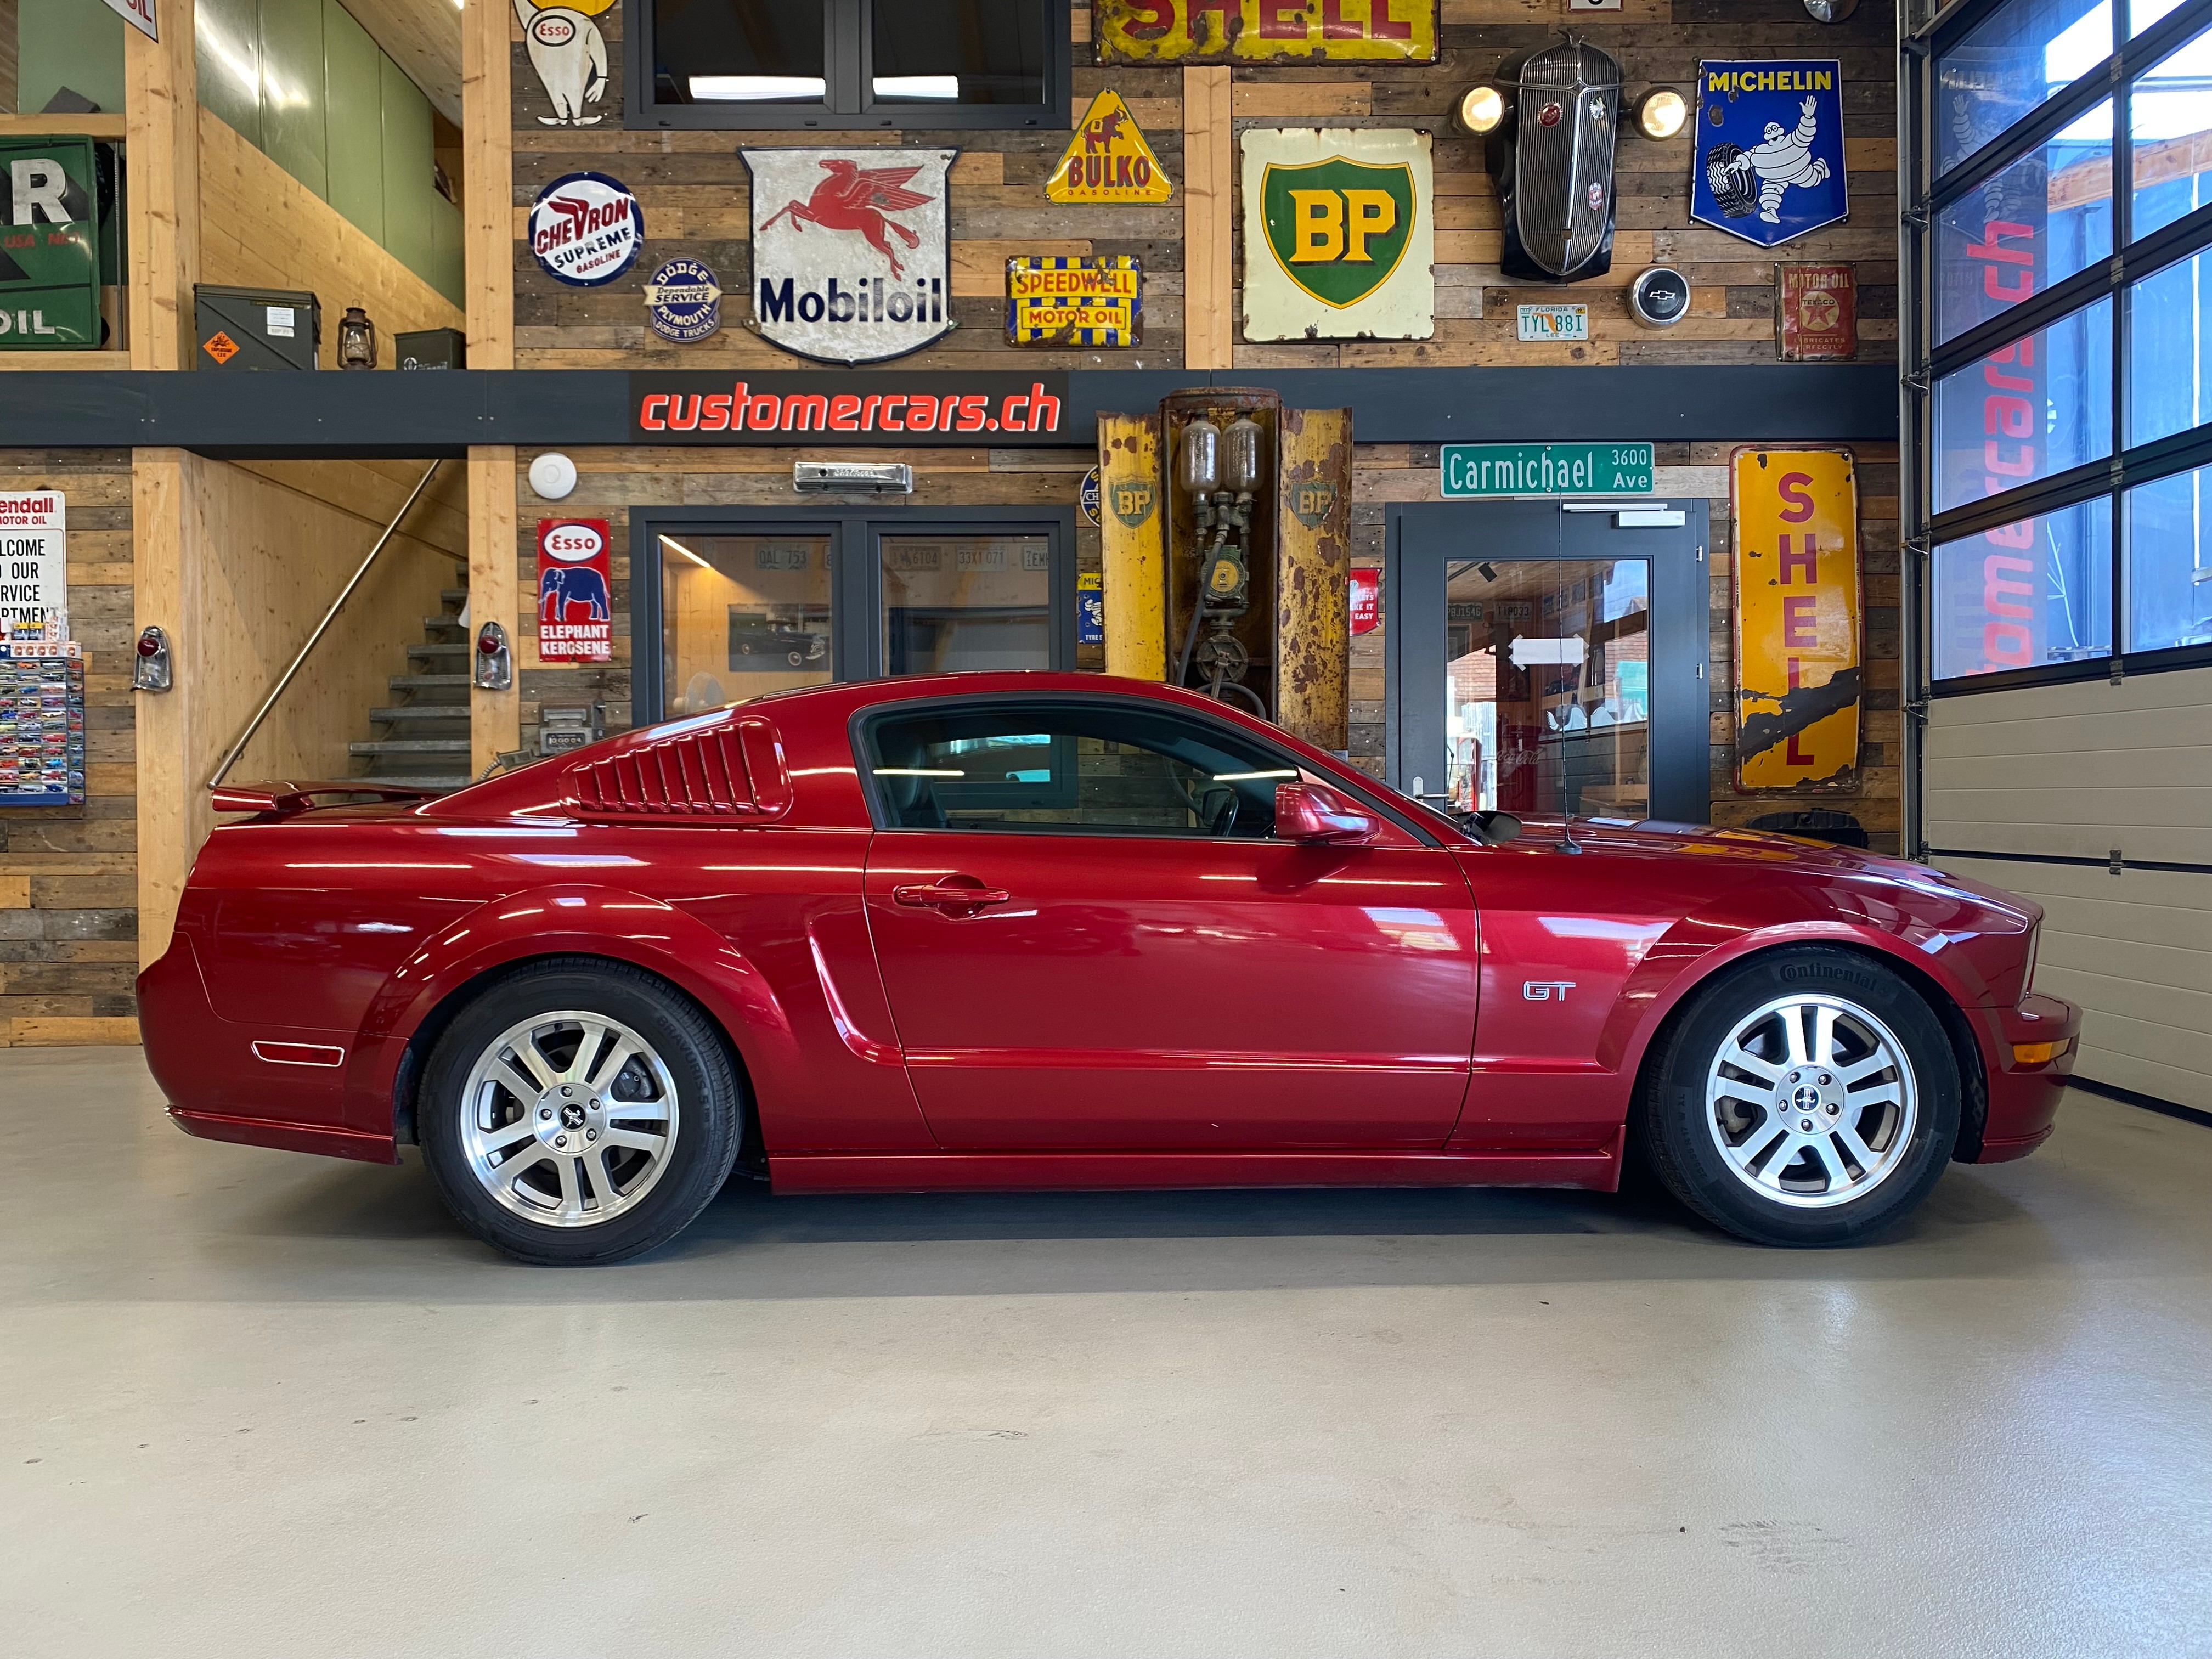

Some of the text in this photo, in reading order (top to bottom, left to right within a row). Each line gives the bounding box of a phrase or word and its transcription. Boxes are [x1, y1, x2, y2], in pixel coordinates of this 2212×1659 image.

[540, 24, 569, 36] Esso
[1120, 0, 1412, 39] SHELL
[1708, 71, 1831, 92] MICHELIN
[1068, 155, 1151, 188] BULKO
[537, 196, 629, 255] CHEVRON
[1289, 189, 1399, 265] BP
[555, 227, 631, 268] SUPREME
[576, 249, 621, 273] GASOLINE
[656, 263, 709, 285] DODGE
[1017, 272, 1131, 294] SPEEDWELL
[1788, 273, 1849, 289] MOTOR OIL
[655, 292, 709, 302] SERVICE
[657, 286, 709, 295] Dependable
[760, 277, 942, 323] Mobiloil
[657, 303, 712, 325] PLYMOUTH
[1029, 310, 1122, 324] MOTOR OIL
[1522, 315, 1549, 332] TYL
[655, 319, 714, 337] DODGE TRUCKS
[639, 381, 1062, 431] customercars.ch
[1450, 449, 1647, 489] Carmichael 3600
[1613, 472, 1647, 488] Ave
[1116, 490, 1151, 515] BP
[1298, 490, 1332, 514] BP
[32, 515, 47, 524] OIL
[552, 534, 595, 550] Esso
[12, 562, 39, 579] OUR
[1, 584, 41, 602] RVICE
[540, 625, 609, 639] ELEPHANT
[541, 641, 611, 655] KEROSENE
[1780, 963, 1878, 991] Continental
[1523, 981, 1576, 1001] GT
[657, 1015, 707, 1091] BRAVURIS
